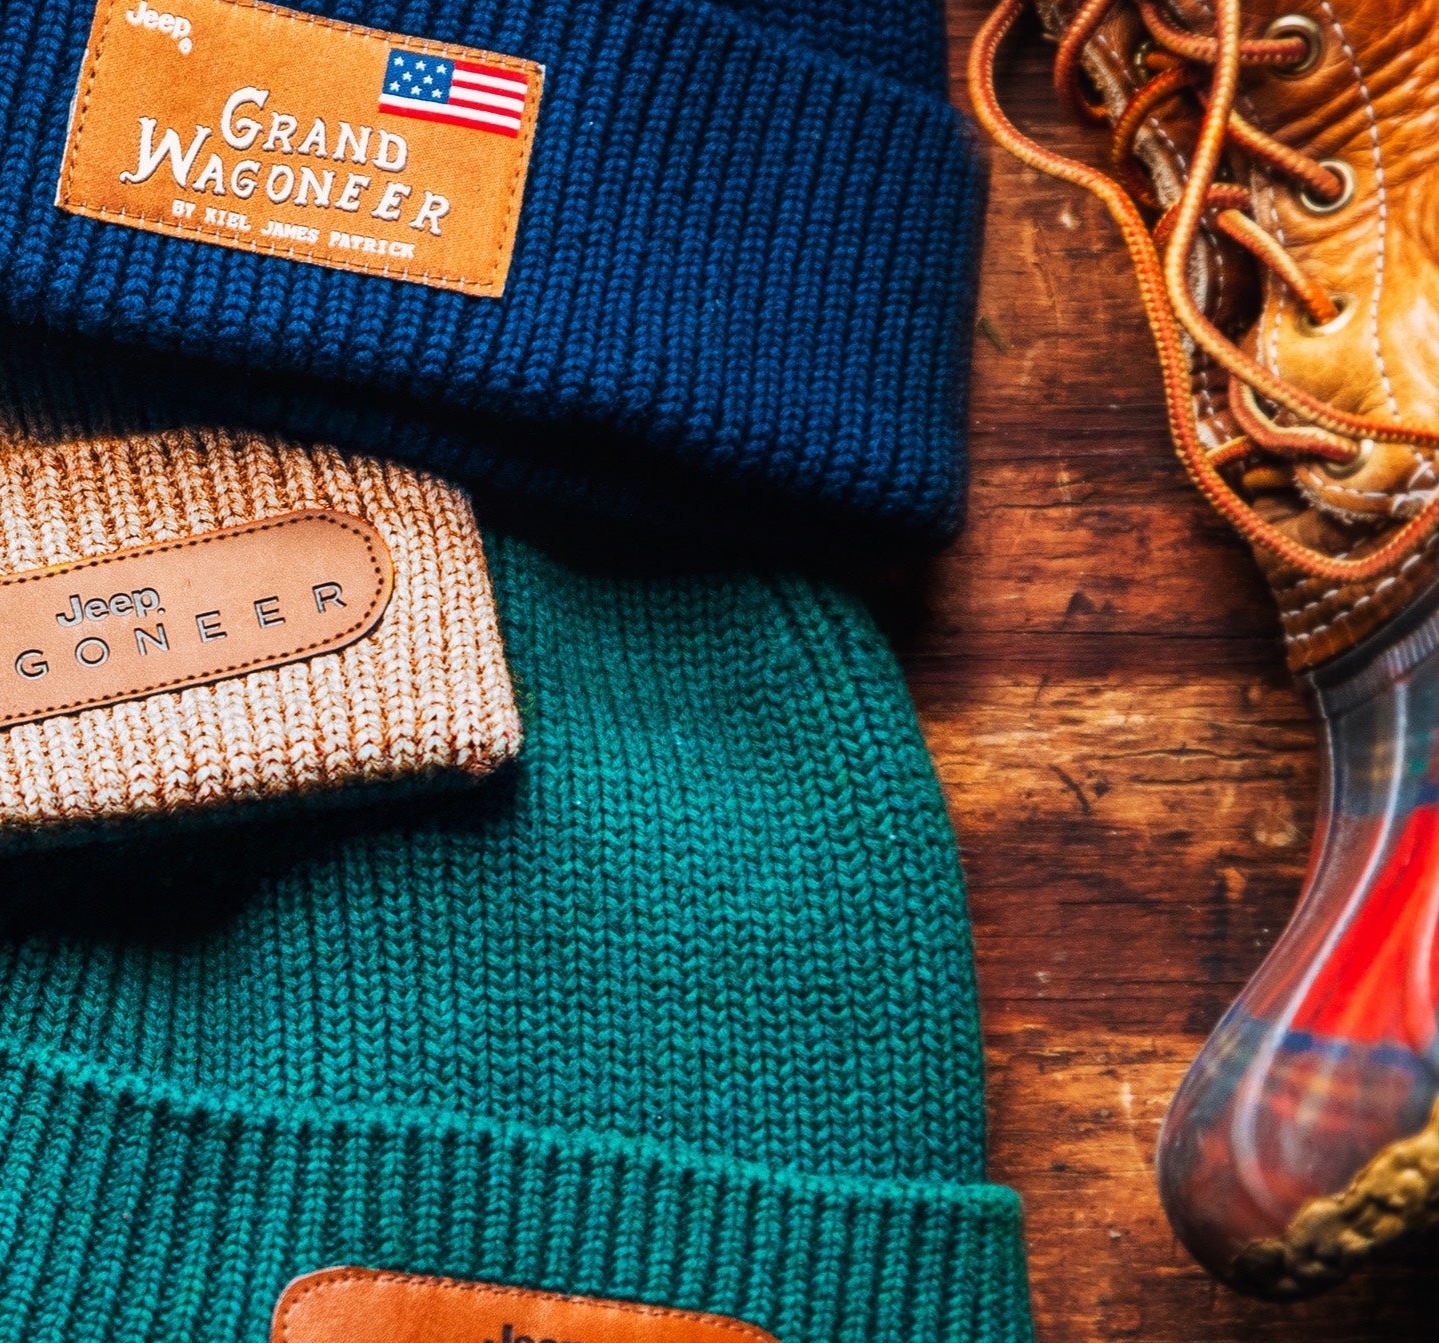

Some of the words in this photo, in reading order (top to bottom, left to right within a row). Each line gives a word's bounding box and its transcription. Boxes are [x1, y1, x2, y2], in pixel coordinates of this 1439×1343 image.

[126, 0, 192, 47] Jeep
[220, 84, 409, 173] GRAND
[119, 115, 451, 236] WAGONEER
[171, 199, 196, 219] BY
[204, 206, 253, 232] KIEL
[260, 218, 321, 244] JAMES
[327, 229, 416, 259] PATRICK
[55, 585, 166, 628] Jeep
